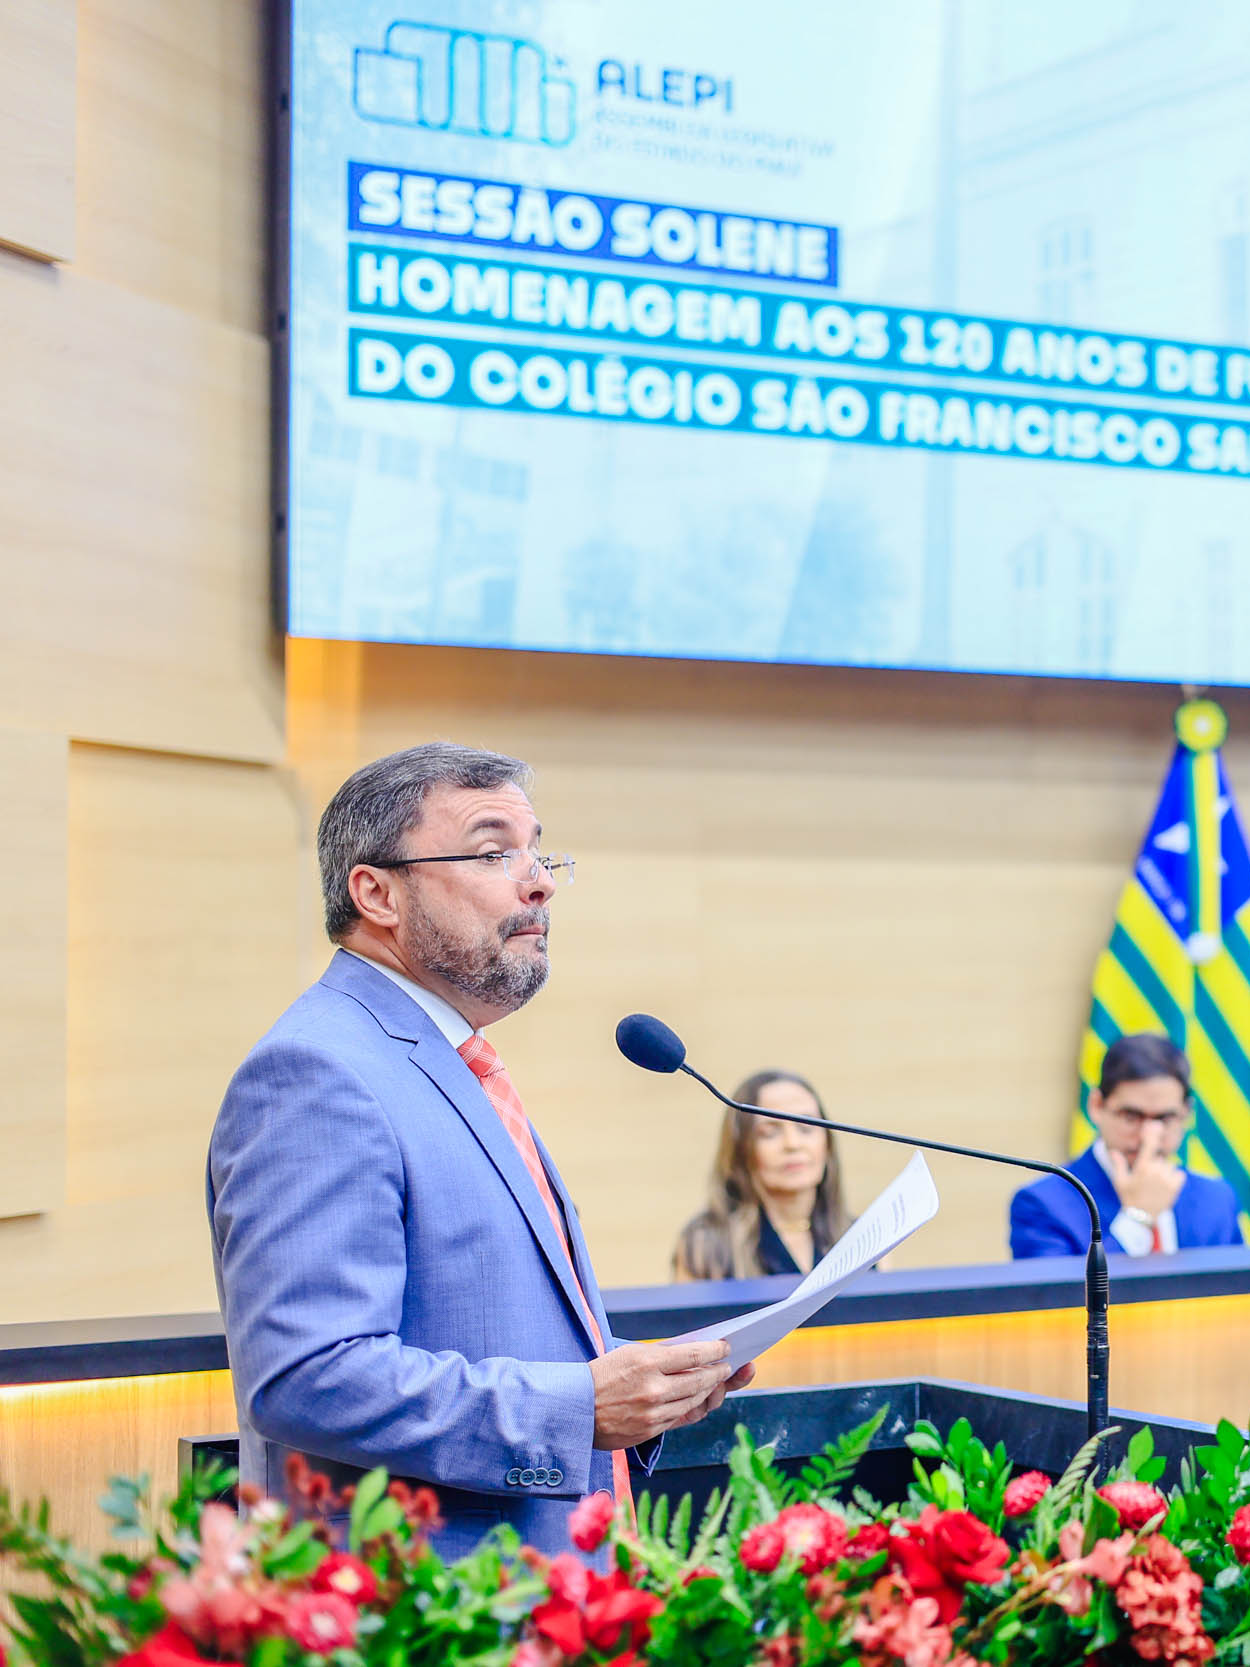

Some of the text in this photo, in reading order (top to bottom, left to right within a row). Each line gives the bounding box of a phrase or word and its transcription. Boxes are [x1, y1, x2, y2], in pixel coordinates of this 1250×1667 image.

[358, 170, 829, 280] SESSÃO SOLENE
[357, 252, 762, 347] HOMENAGEM
[774, 302, 890, 360] AOS
[899, 315, 994, 373] 120
[1000, 327, 1147, 389] ANOS
[1155, 345, 1219, 399] DE
[357, 338, 456, 399] DO
[879, 390, 1180, 467] FRANCISCO
